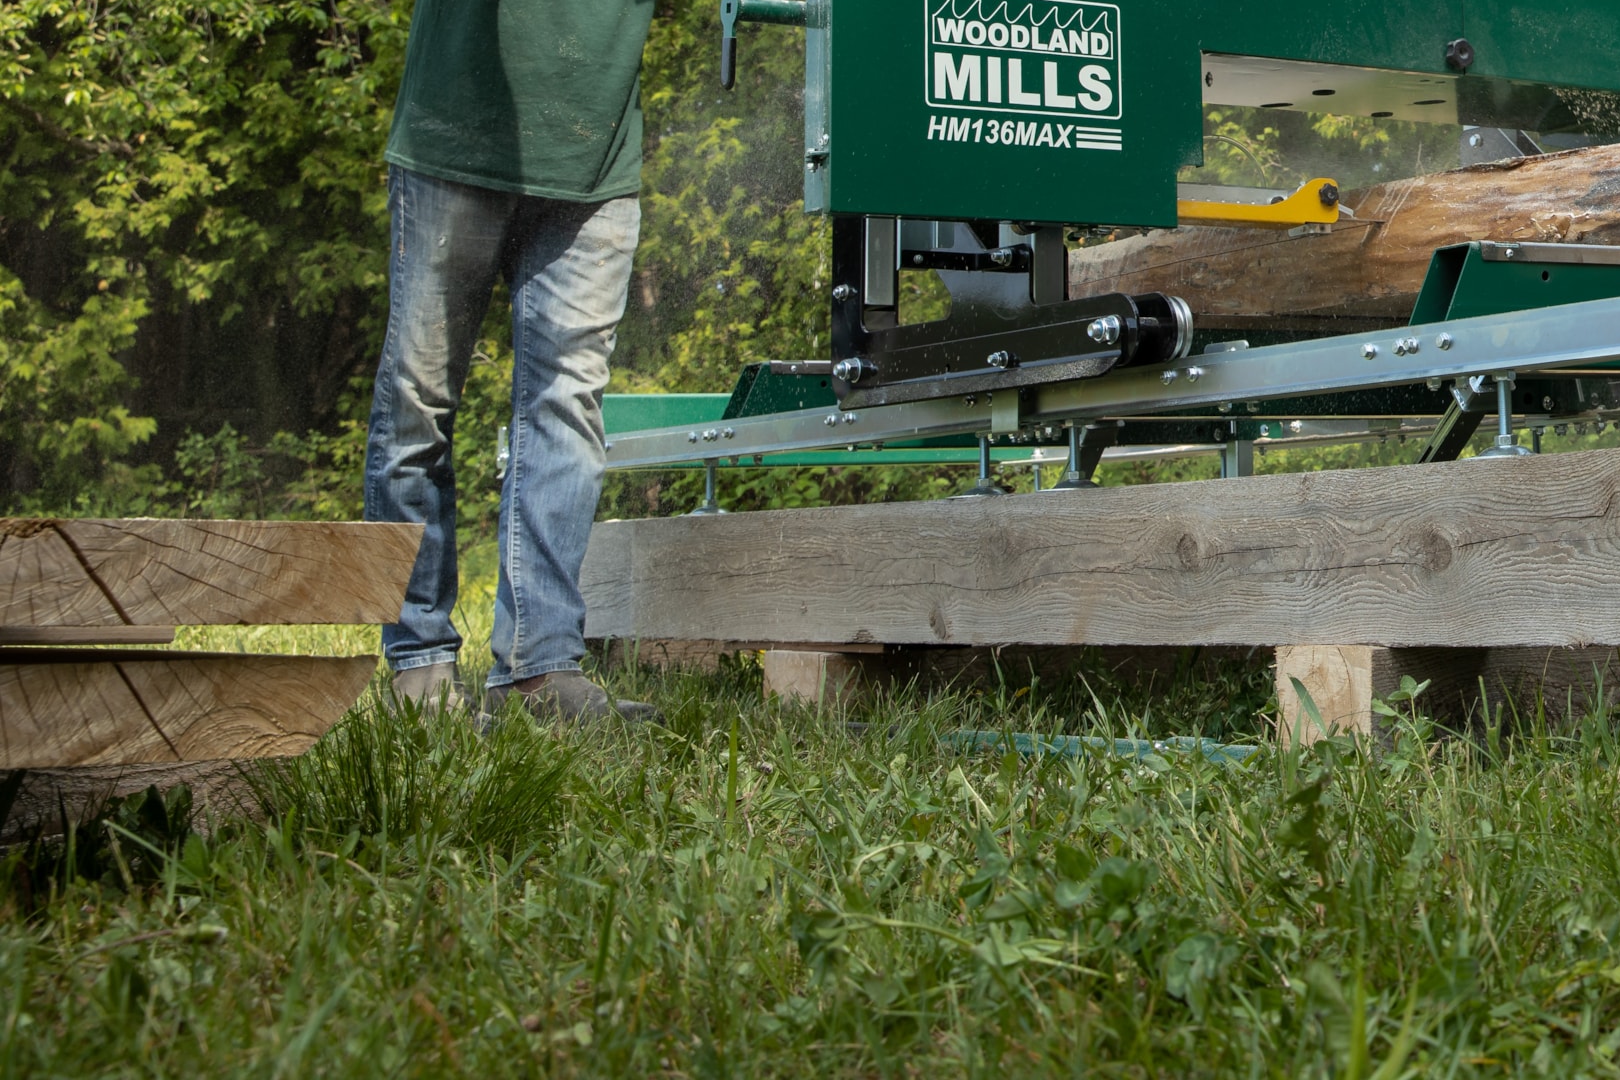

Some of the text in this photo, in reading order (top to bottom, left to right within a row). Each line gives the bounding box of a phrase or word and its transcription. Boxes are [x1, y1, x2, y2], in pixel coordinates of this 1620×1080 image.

[937, 18, 1109, 56] WOODLAND
[934, 51, 1113, 111] MILLS
[927, 115, 1075, 149] HM136MAX
